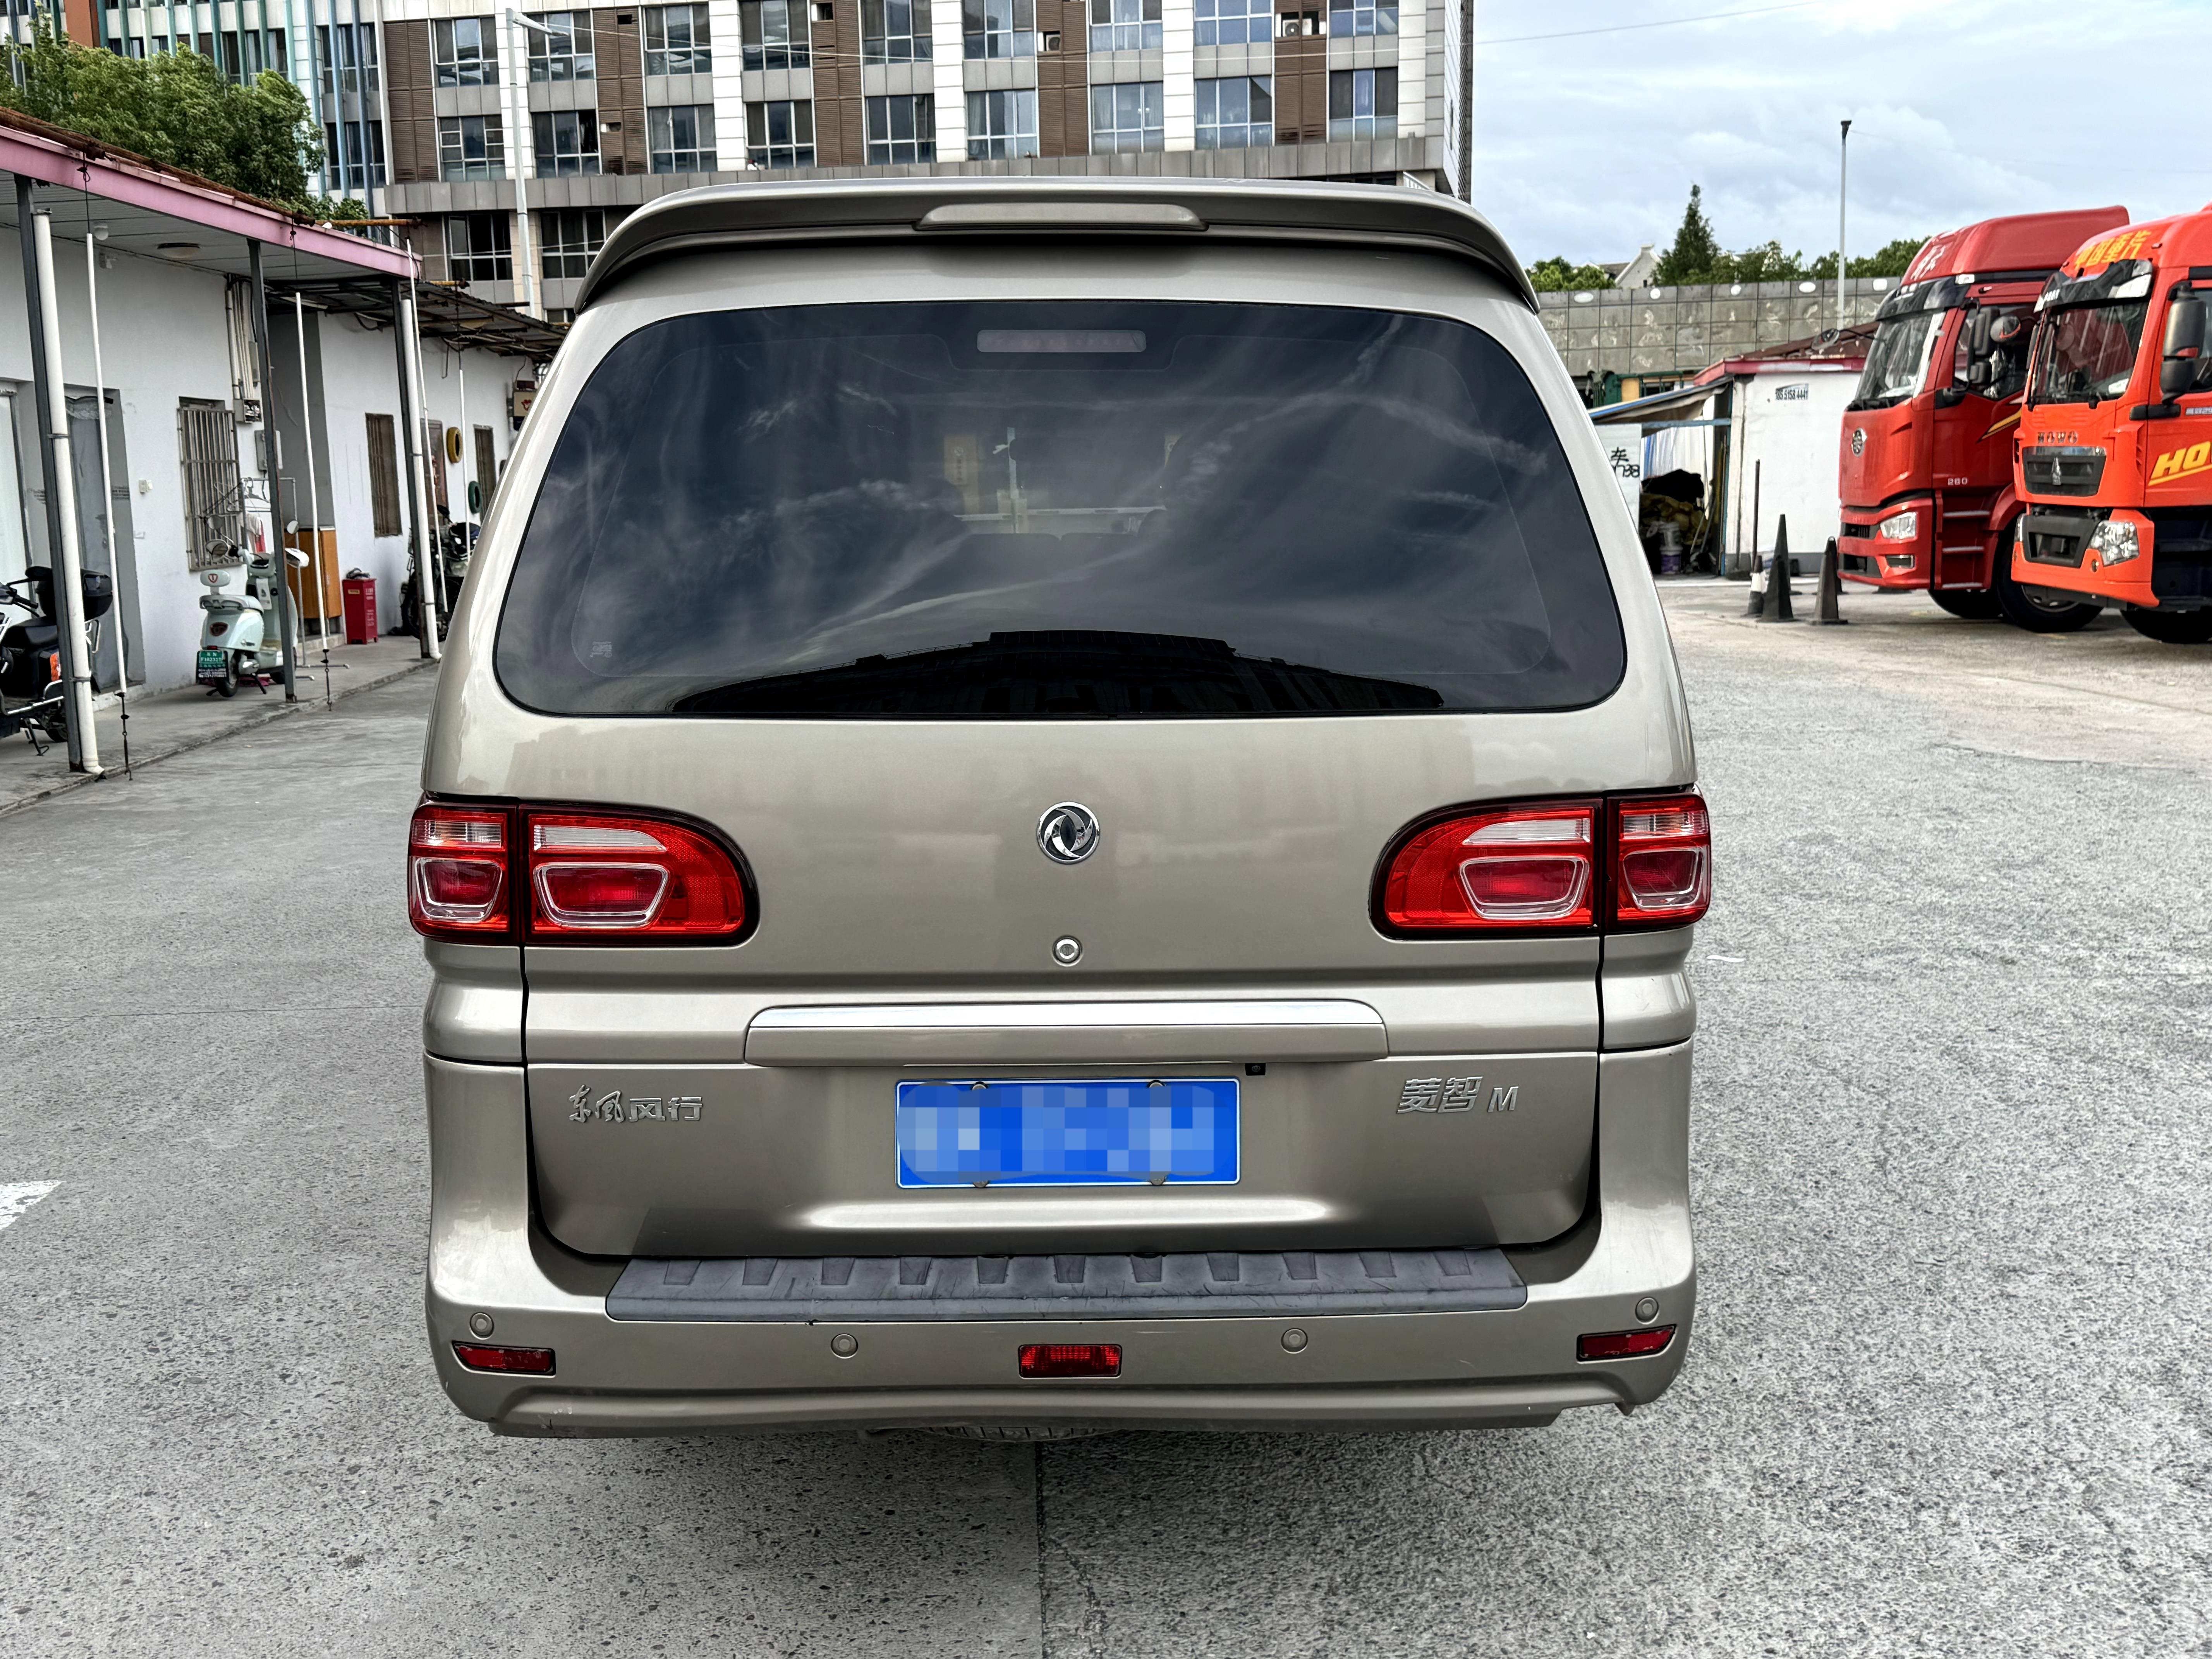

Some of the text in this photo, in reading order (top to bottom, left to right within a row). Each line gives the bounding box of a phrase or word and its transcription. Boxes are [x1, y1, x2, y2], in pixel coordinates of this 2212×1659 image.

[2038, 431, 2078, 443] HOWO
[1396, 1076, 1519, 1114] 菱智 M
